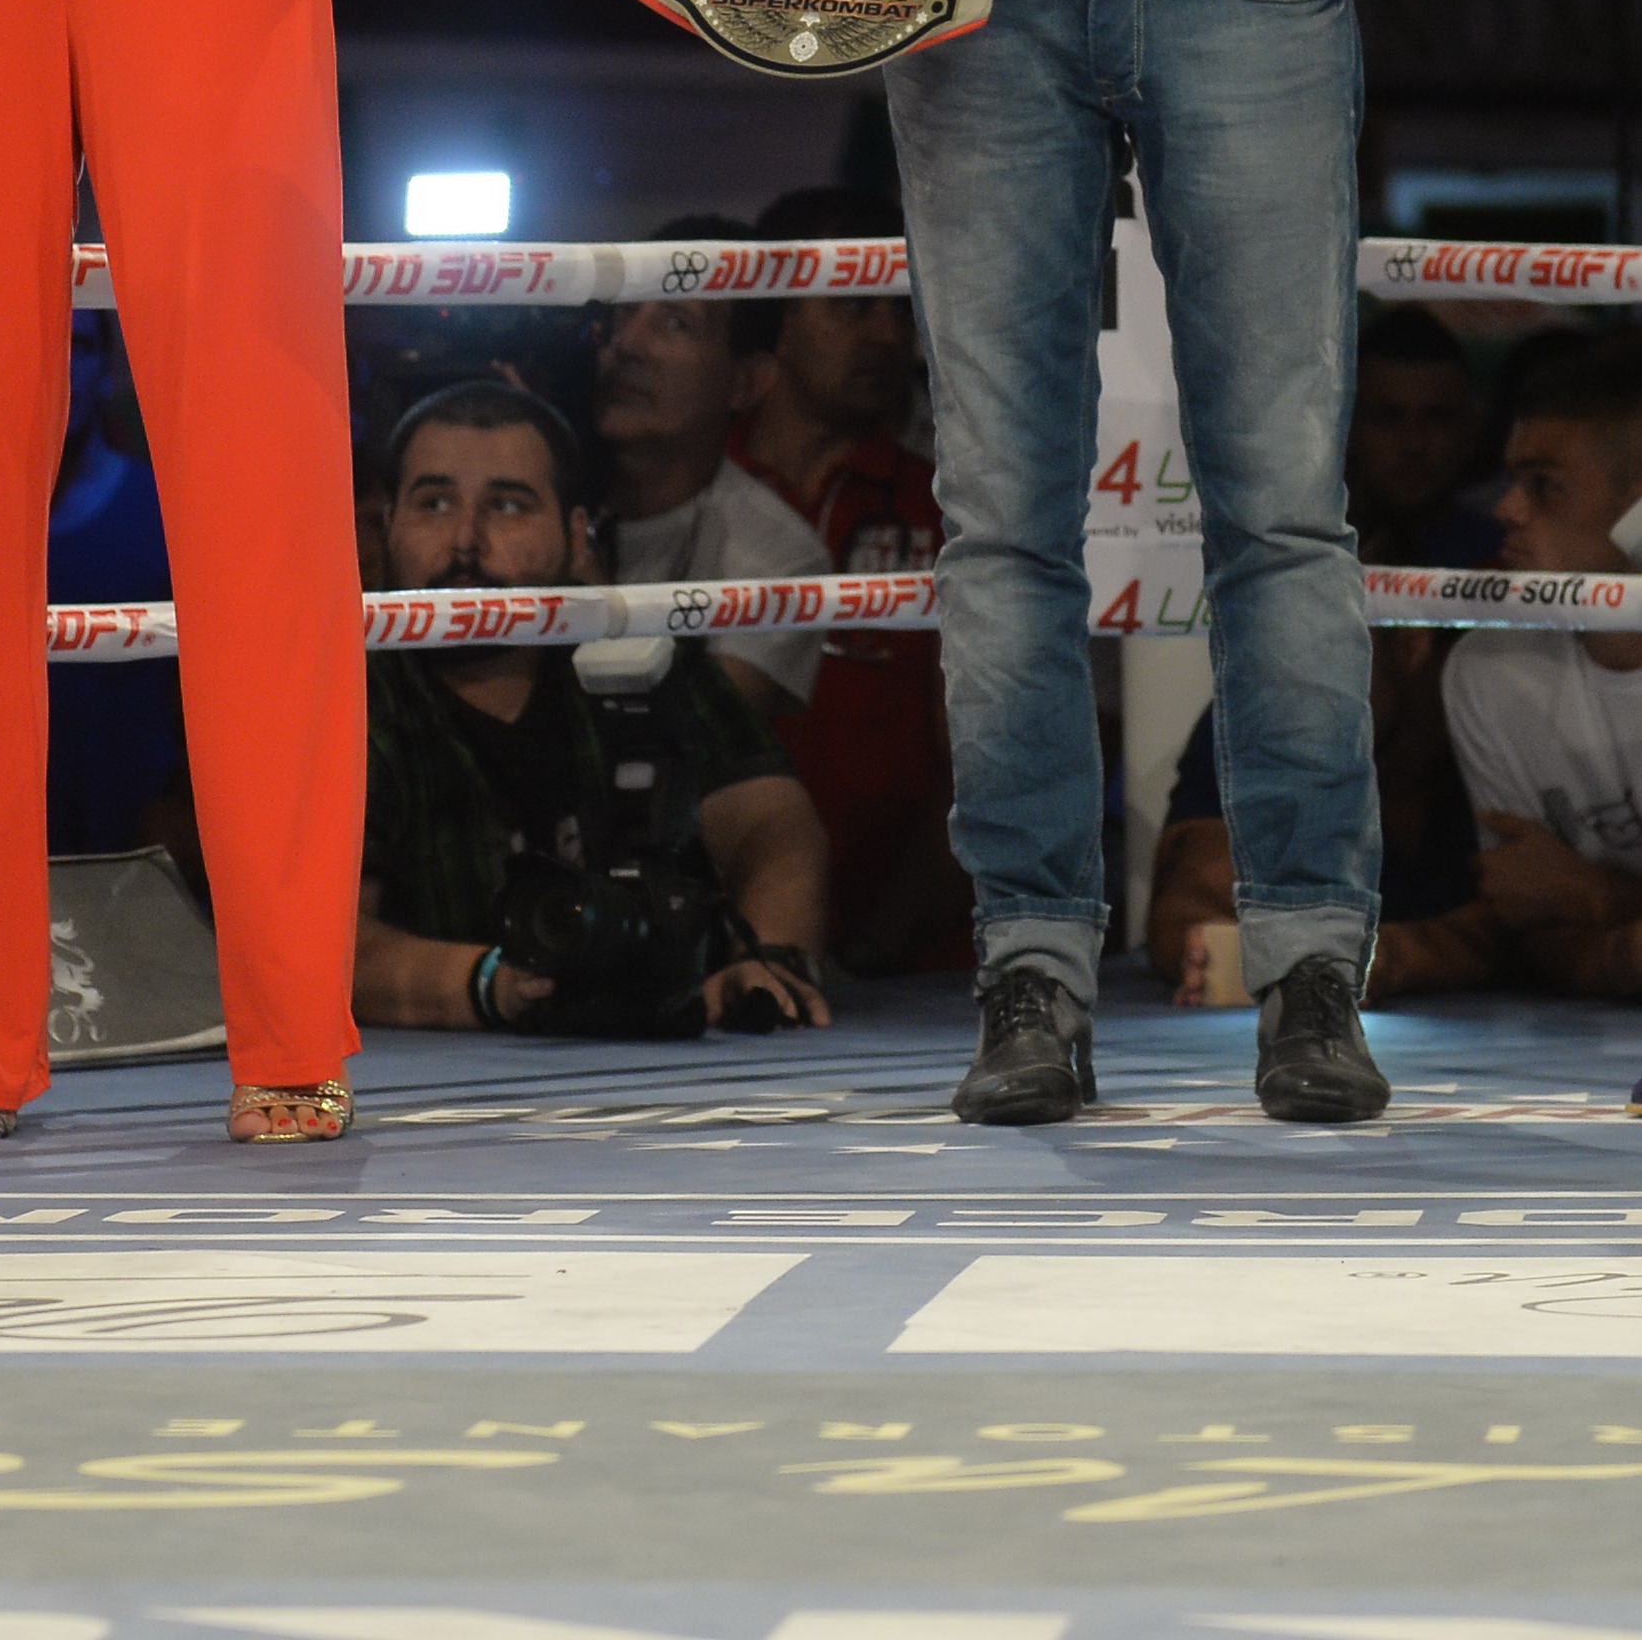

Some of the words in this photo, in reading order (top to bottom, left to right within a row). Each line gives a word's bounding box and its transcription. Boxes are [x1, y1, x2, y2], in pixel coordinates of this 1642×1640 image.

[429, 253, 554, 294] SOFT
[704, 246, 820, 291] AUTO
[828, 246, 908, 288] SOF
[1423, 244, 1521, 284] AUTO
[1529, 247, 1642, 290] SOFT
[443, 597, 564, 642] SOFT
[711, 584, 825, 626] AUTO
[48, 608, 148, 650] OFT
